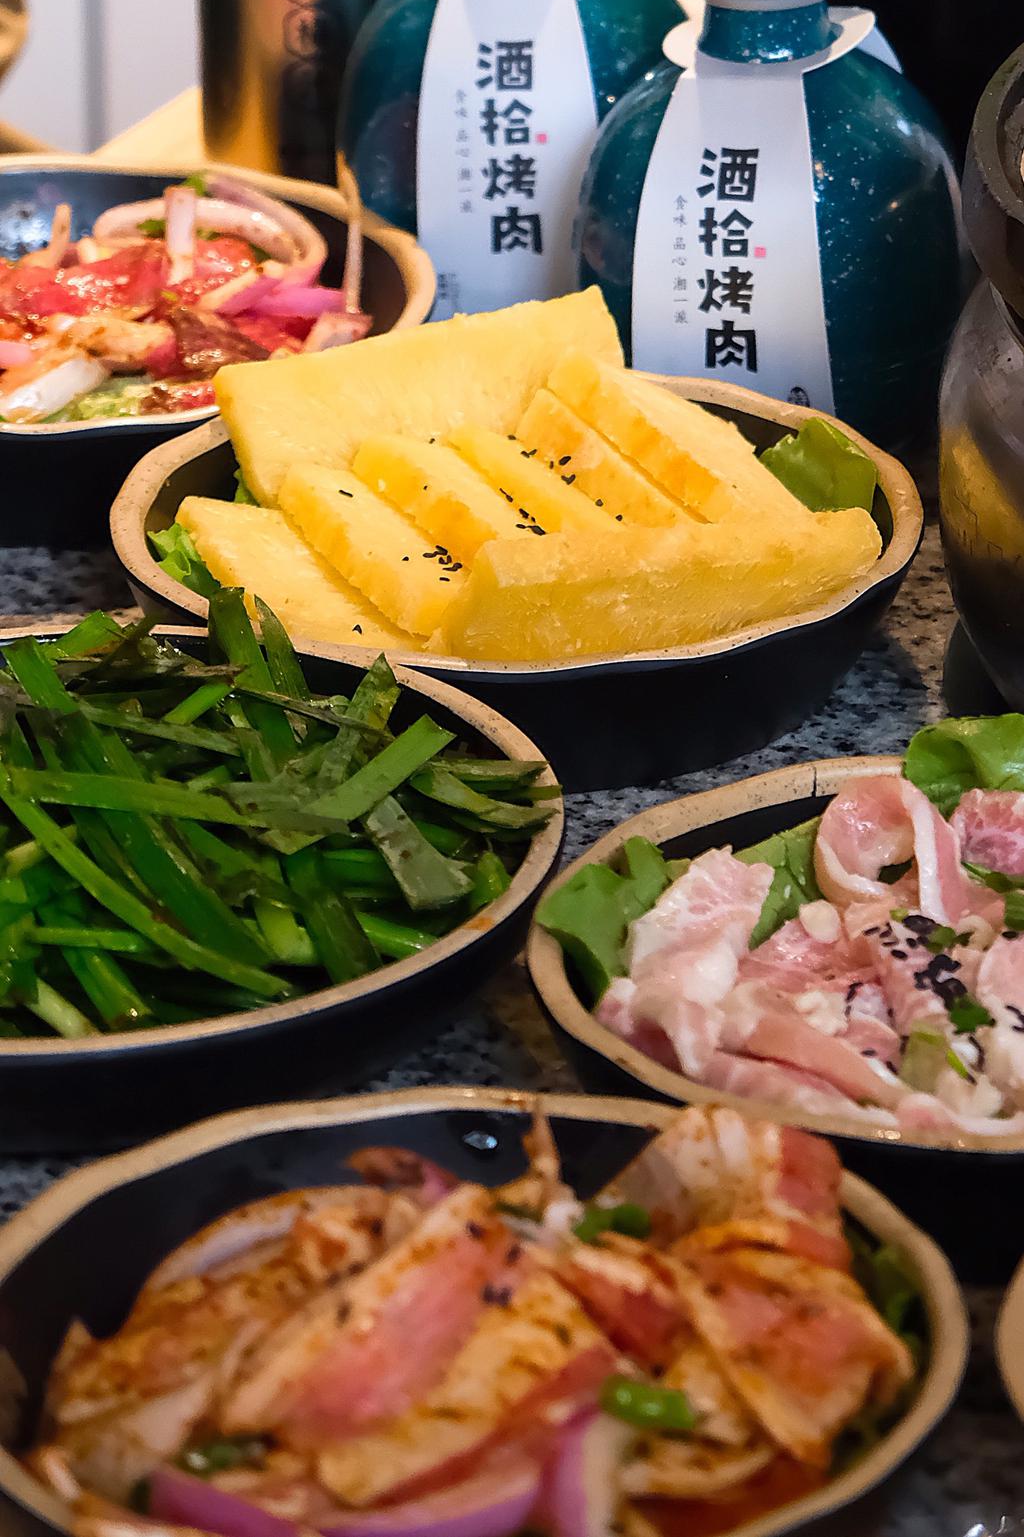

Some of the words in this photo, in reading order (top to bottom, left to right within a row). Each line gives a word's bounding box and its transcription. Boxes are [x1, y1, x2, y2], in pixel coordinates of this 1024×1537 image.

[475, 41, 543, 254] 酒拾烤肉
[696, 147, 760, 373] 酒拾烤肉
